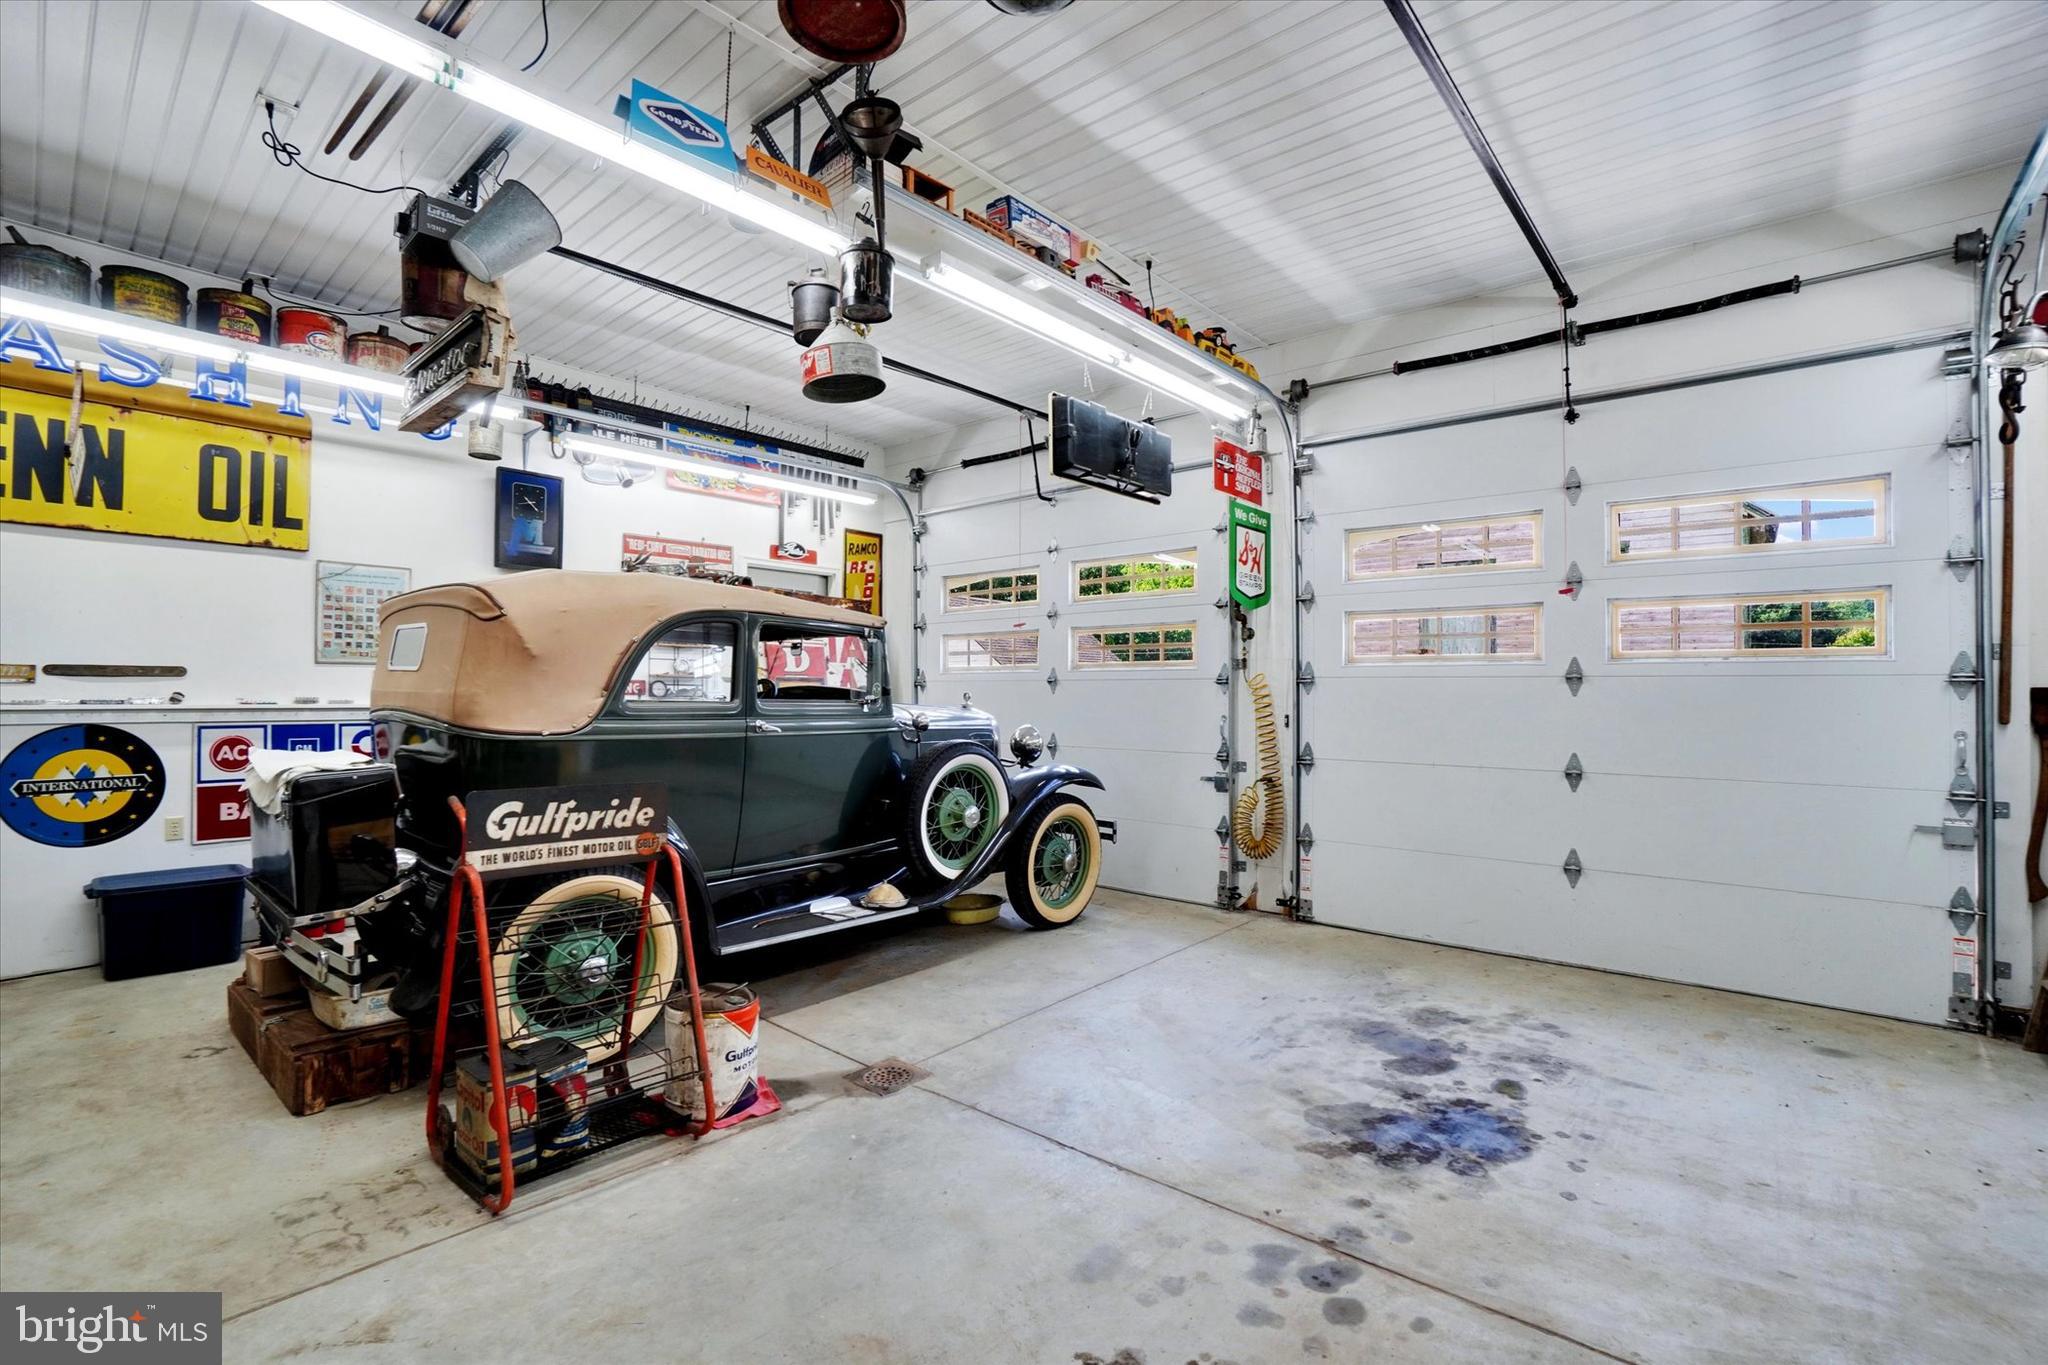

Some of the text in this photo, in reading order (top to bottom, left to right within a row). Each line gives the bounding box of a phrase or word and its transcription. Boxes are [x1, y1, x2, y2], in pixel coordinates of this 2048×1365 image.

[650, 105, 716, 143] GOODYEAR
[754, 155, 822, 198] CAVALIER
[620, 433, 657, 449] HERE
[198, 443, 304, 531] OIL
[1234, 507, 1268, 527] We Give
[848, 542, 878, 556] RAMCO
[1239, 572, 1263, 582] GREEN
[1239, 580, 1263, 591] STAMPS
[22, 777, 142, 793] INTERNATIONAL
[485, 797, 656, 841] Gulfpride
[480, 840, 632, 866] THE WORLD'S FINEST MOTOR OIL
[636, 839, 659, 850] GULF
